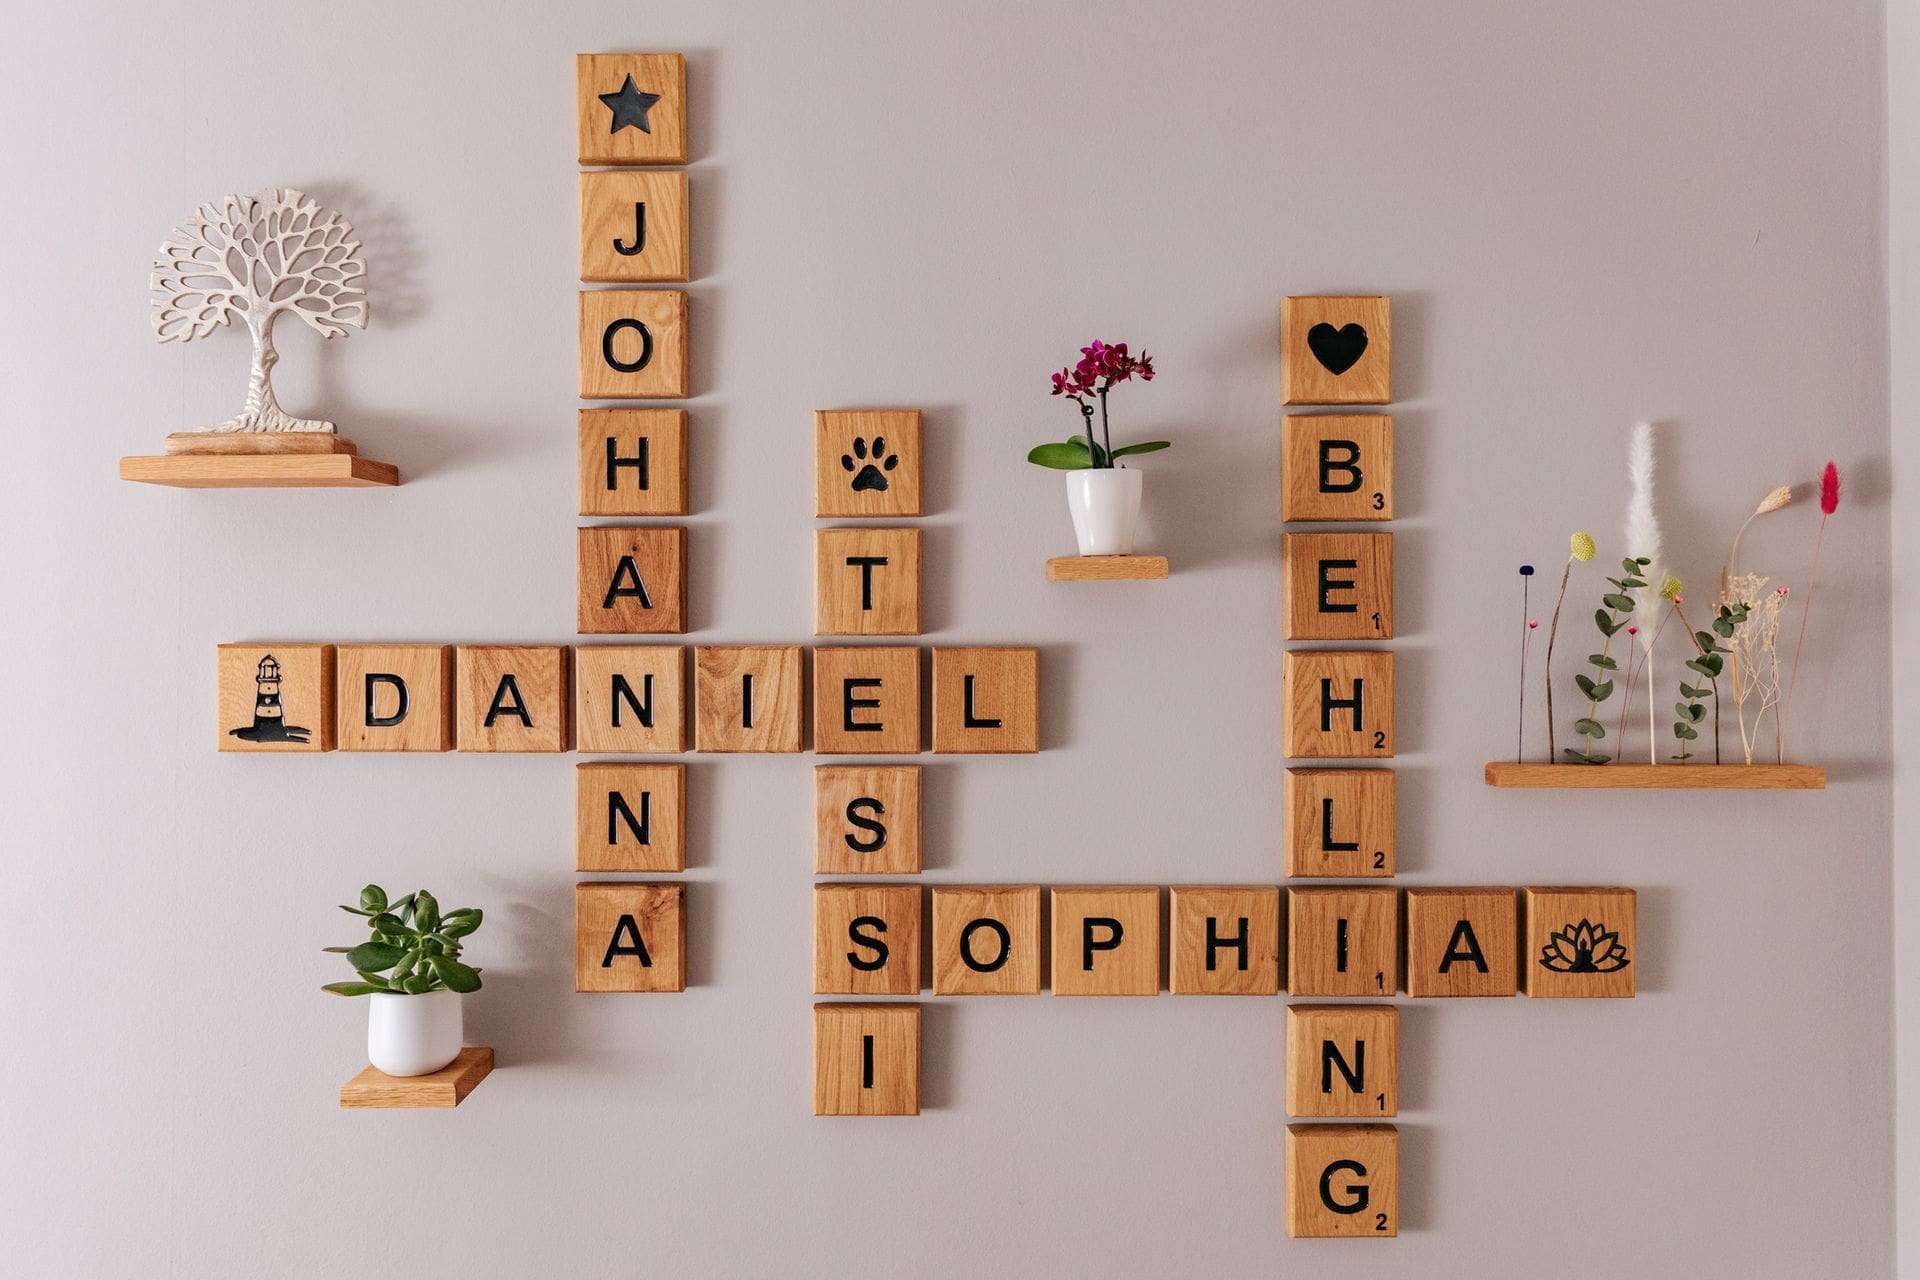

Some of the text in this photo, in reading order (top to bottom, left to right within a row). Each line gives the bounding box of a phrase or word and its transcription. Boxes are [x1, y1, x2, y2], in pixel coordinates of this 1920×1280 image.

[1372, 492, 1386, 510] 3
[601, 202, 655, 969] JOHANNA
[1371, 612, 1381, 630] 1
[364, 673, 1003, 732] DANIEL
[1373, 731, 1386, 749] 2
[844, 556, 890, 1089] TESSI
[1318, 439, 1371, 1215] BEHLING
[1373, 851, 1386, 869] 2
[846, 916, 1490, 974] SOPHIA
[1374, 971, 1385, 990] 1
[1375, 1093, 1386, 1111] 1
[1375, 1213, 1387, 1231] 2
